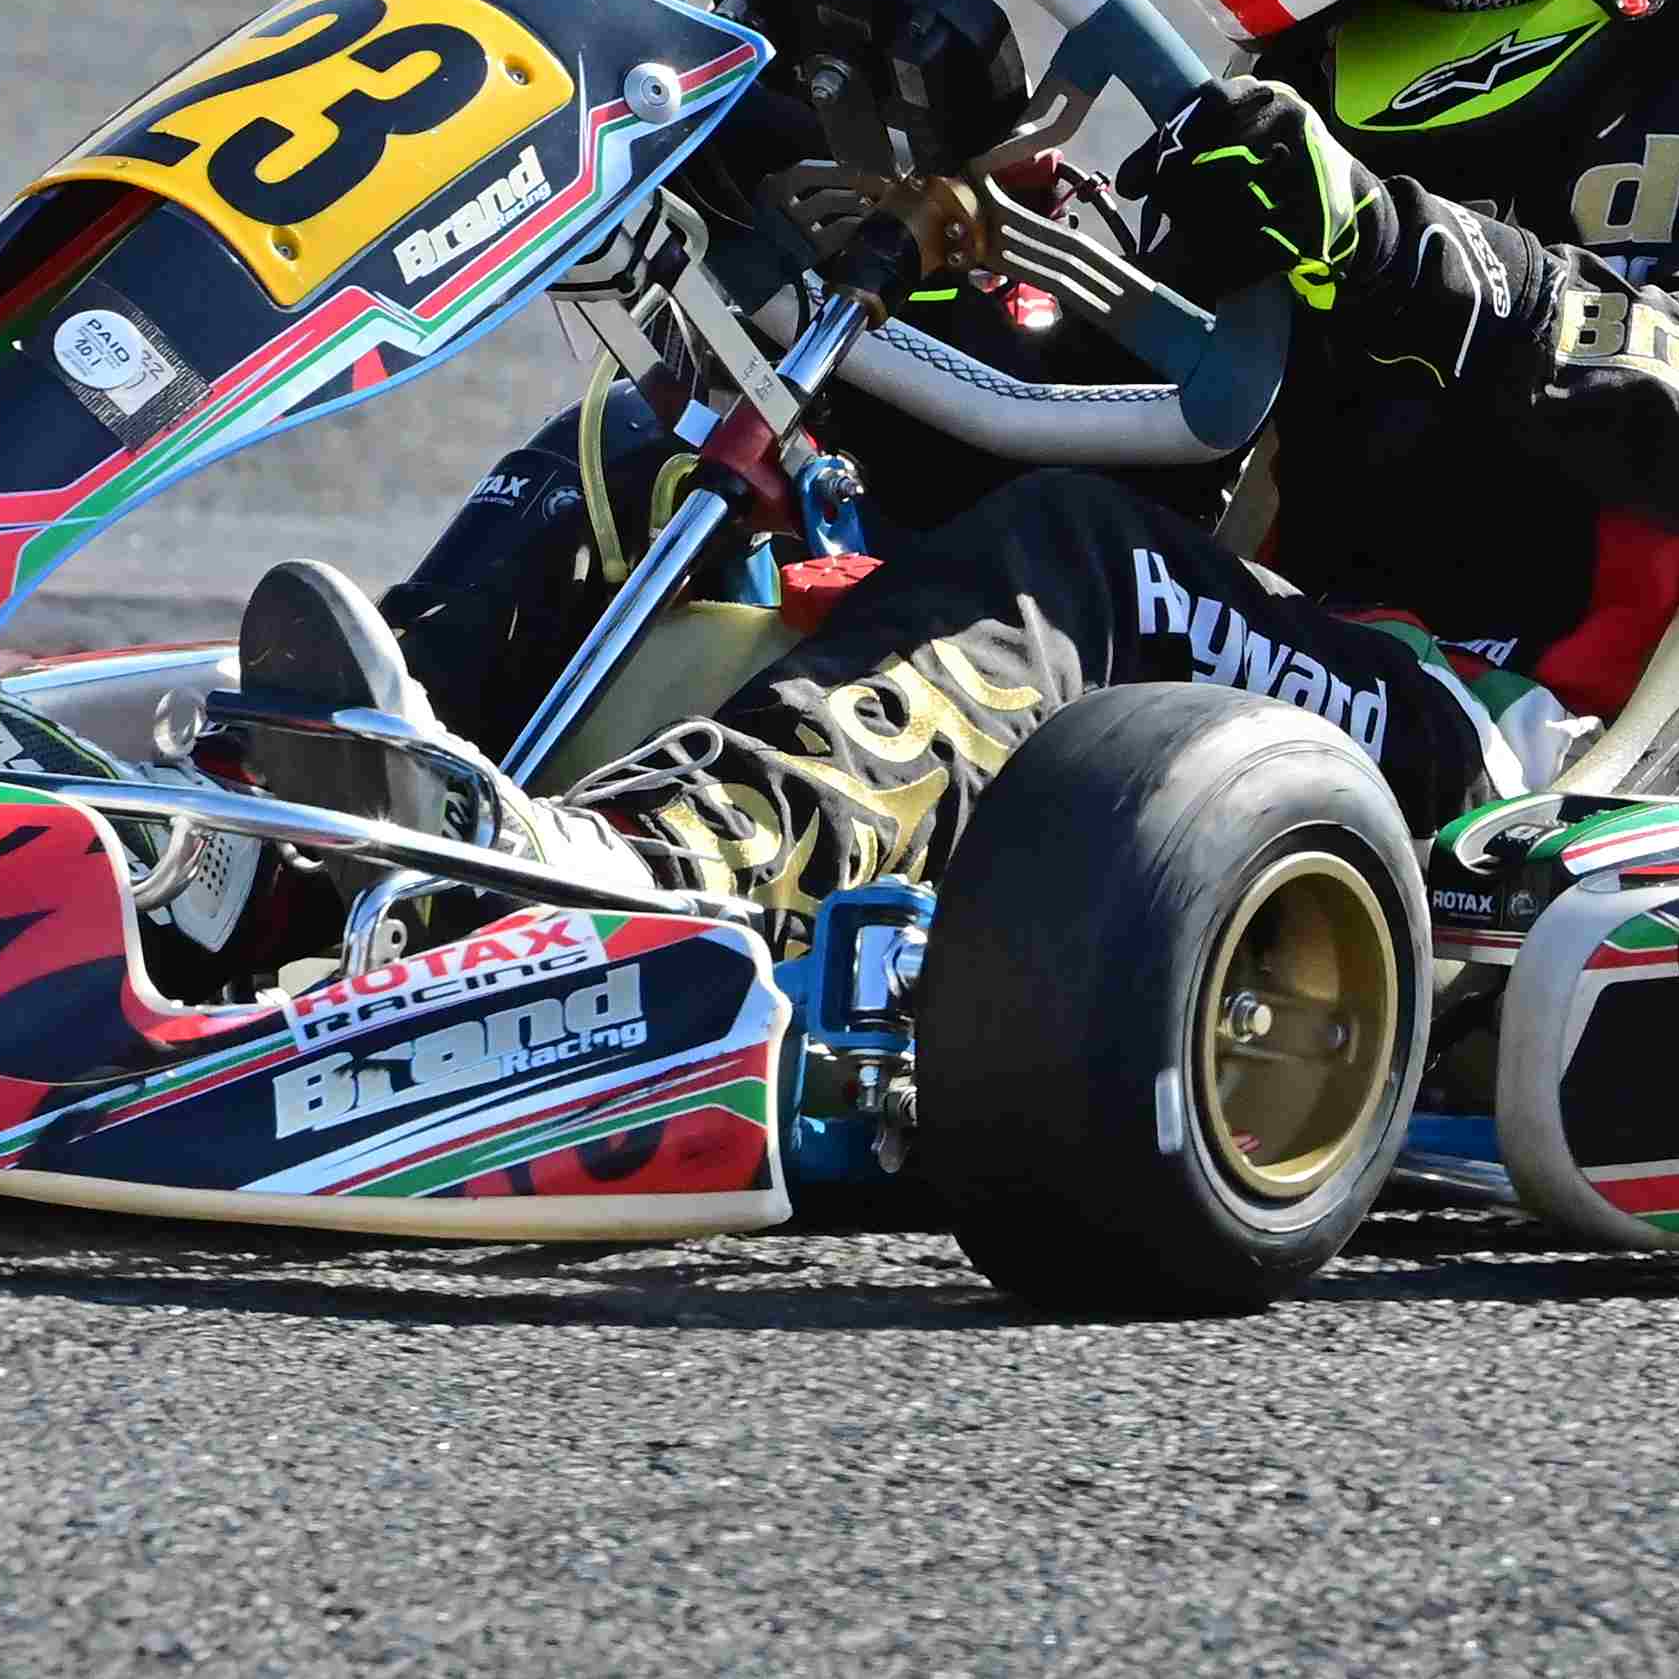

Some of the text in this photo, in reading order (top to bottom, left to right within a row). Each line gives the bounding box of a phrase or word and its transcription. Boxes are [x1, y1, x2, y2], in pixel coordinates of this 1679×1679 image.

[393, 145, 546, 285] Brand
[87, 318, 131, 363] PAID
[1432, 890, 1494, 914] ROTAX
[293, 921, 581, 1018] ROTAX
[272, 963, 644, 1140] Brand
[499, 1020, 648, 1077] Racing
